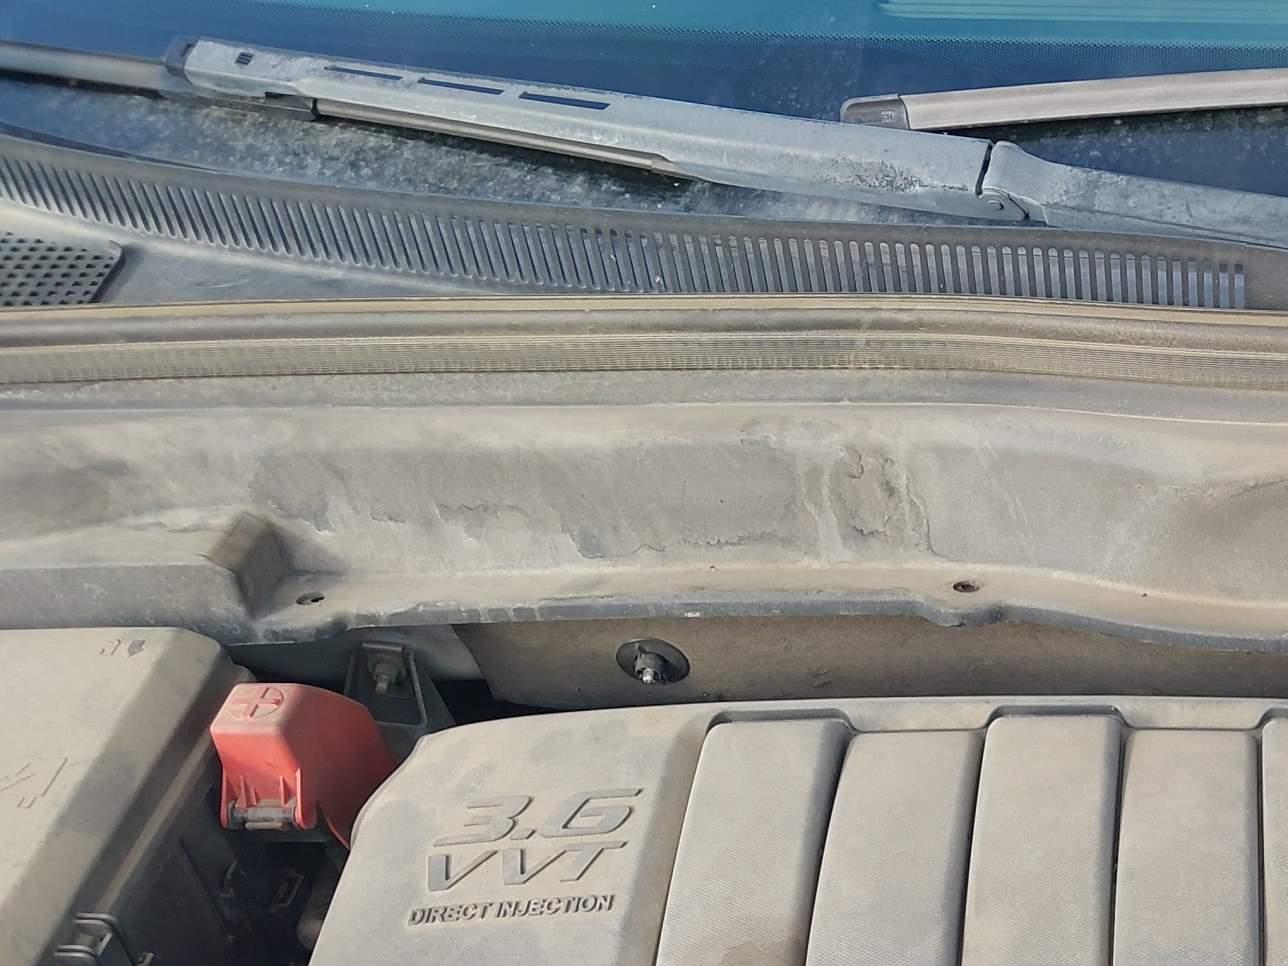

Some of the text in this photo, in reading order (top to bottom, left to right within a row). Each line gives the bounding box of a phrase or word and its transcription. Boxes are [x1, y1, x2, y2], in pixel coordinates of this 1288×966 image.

[433, 787, 644, 846] 3.6
[427, 840, 630, 891] VVT
[408, 895, 615, 926] DIRECT INJECTION
